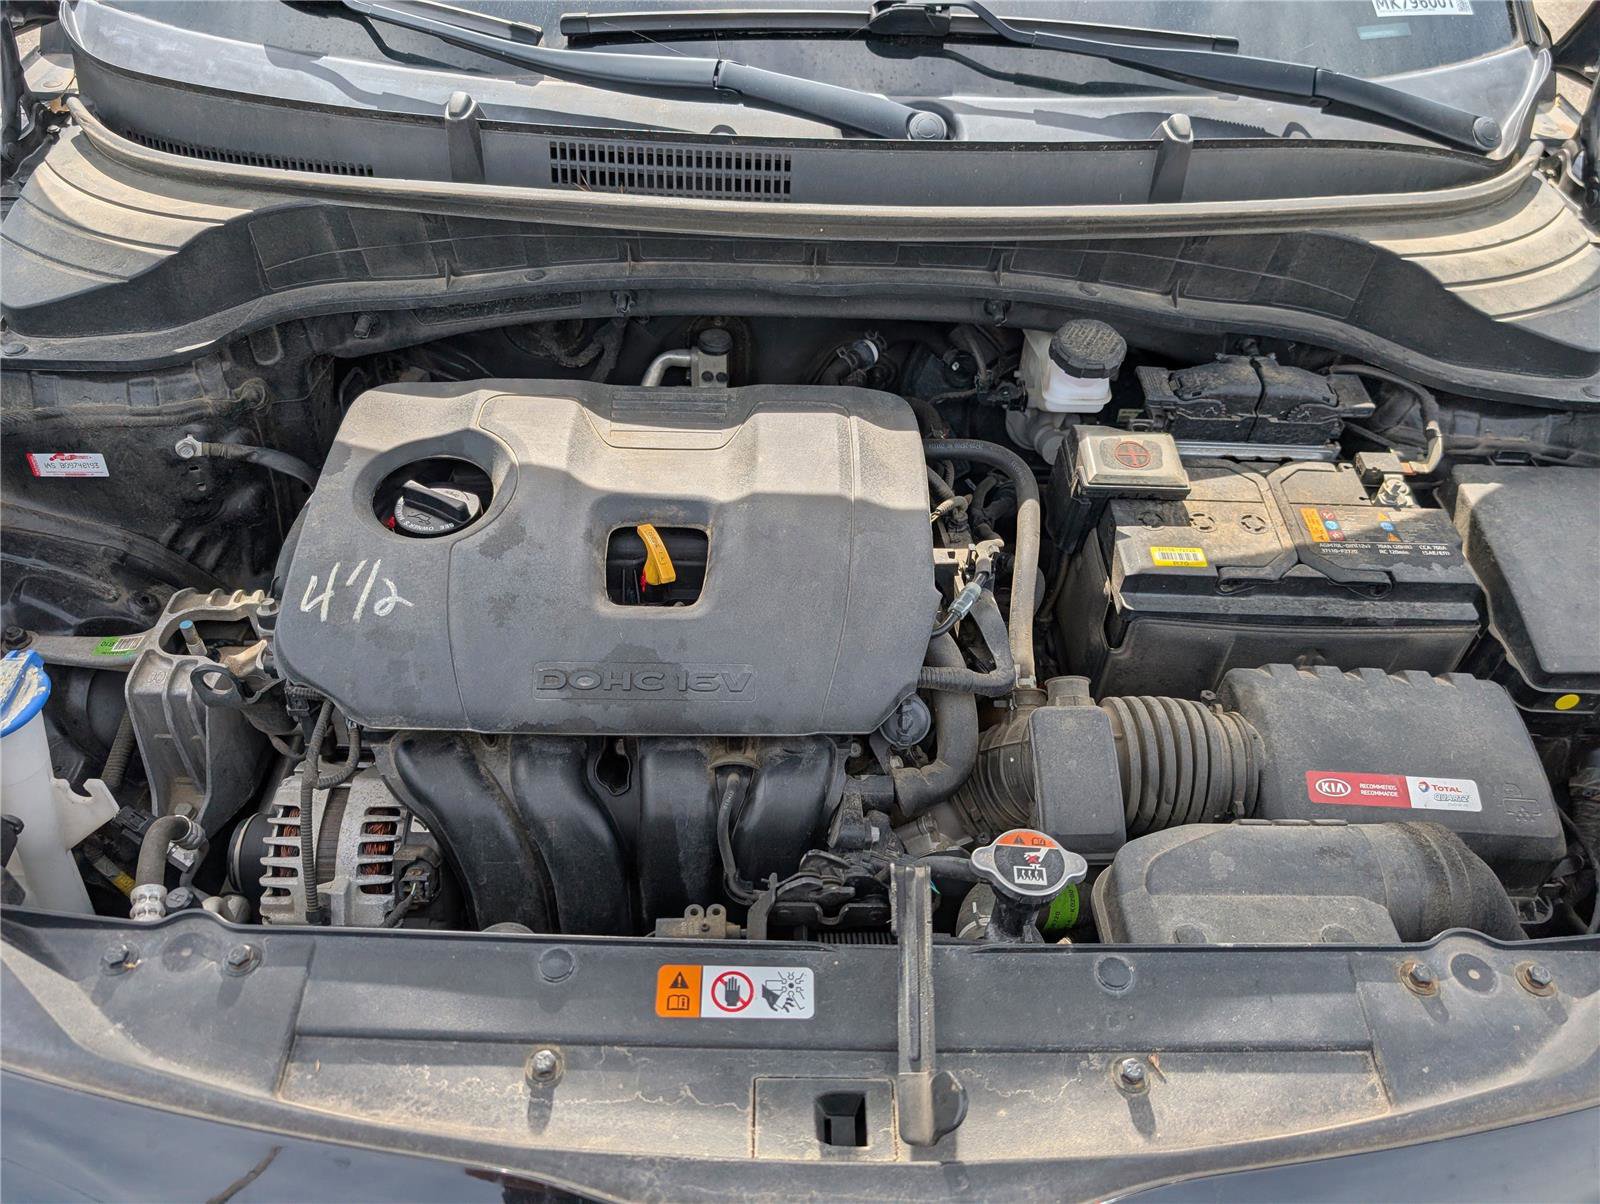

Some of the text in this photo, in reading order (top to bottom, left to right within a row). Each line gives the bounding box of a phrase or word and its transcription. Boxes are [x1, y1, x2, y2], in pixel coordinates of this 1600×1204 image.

[536, 669, 665, 692] DOHC
[1320, 781, 1346, 795] KIA
[1433, 793, 1471, 803] QUARTZ
